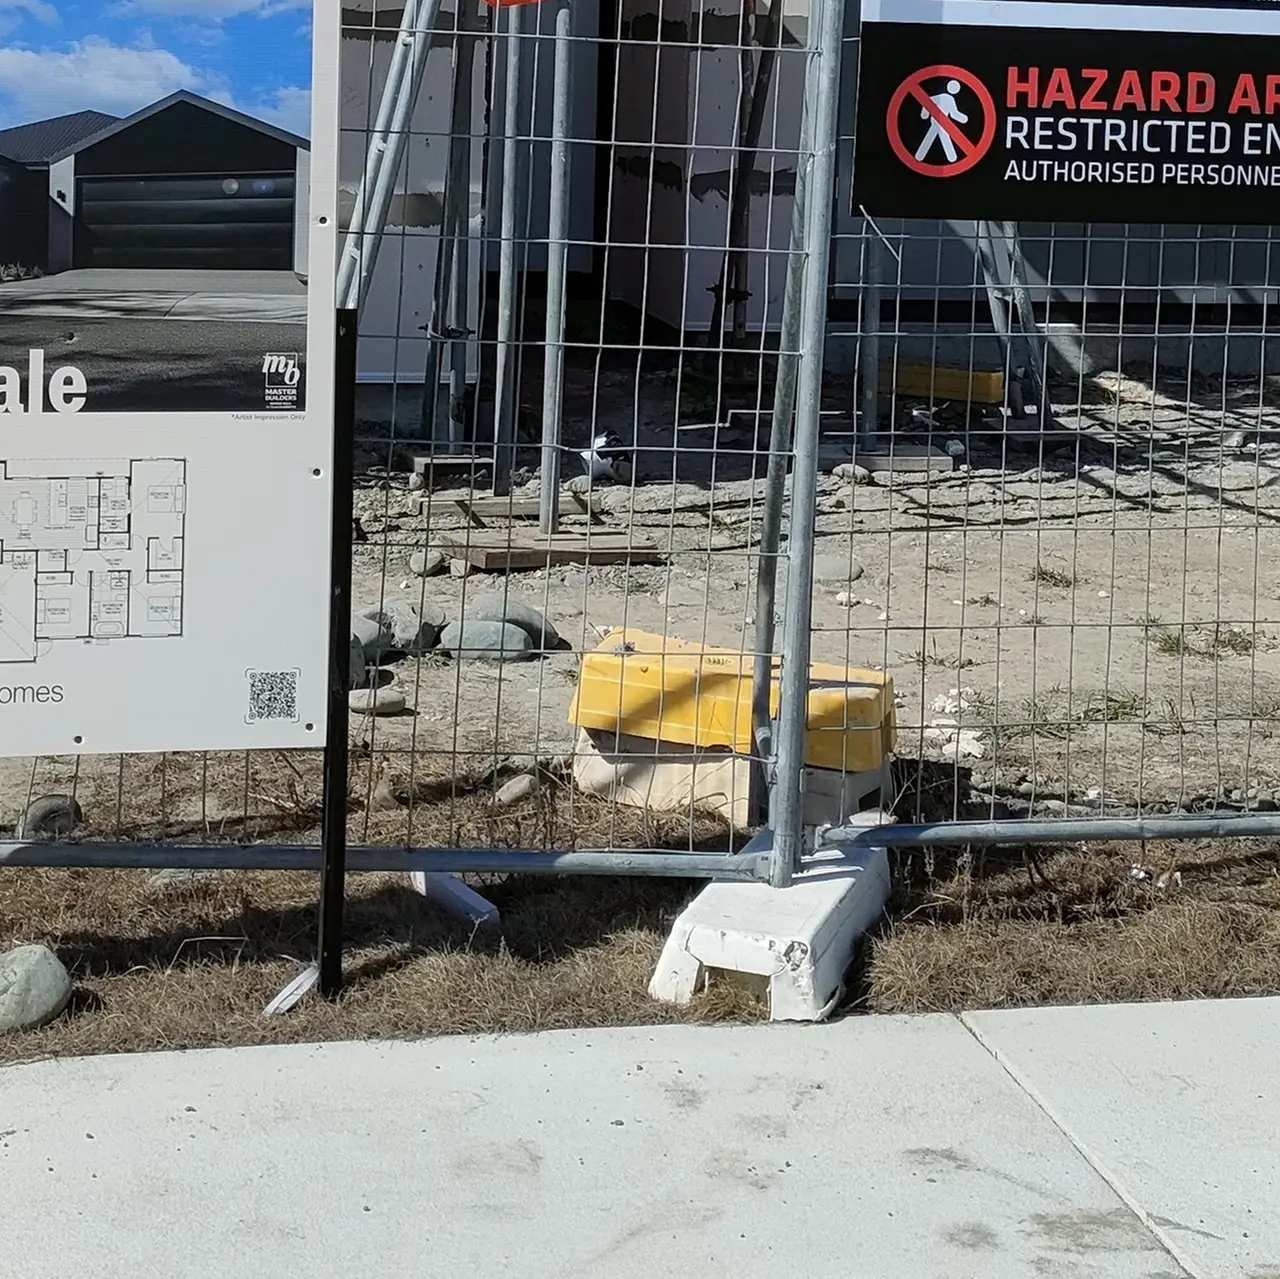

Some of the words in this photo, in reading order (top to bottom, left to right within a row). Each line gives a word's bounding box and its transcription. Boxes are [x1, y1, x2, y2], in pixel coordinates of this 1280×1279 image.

[1006, 67, 1215, 113] HAZARD
[1005, 116, 1231, 154] RESTRICTED
[1004, 160, 1155, 184] AUTHORISED
